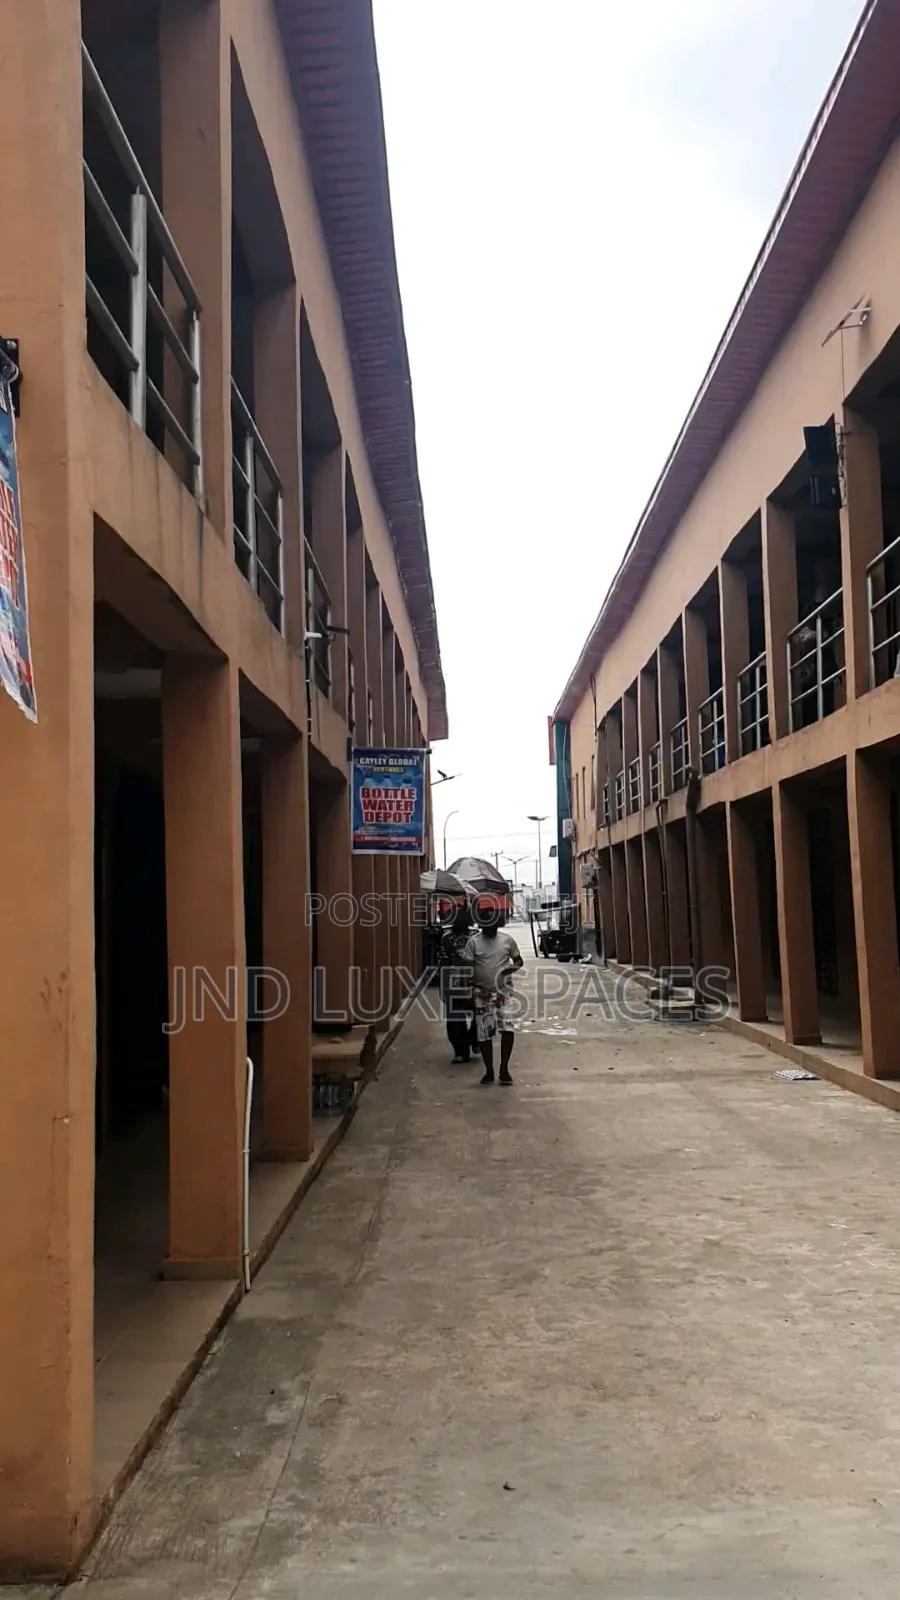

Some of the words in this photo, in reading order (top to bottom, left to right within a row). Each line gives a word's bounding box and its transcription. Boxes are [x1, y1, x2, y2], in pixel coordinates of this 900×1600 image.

[388, 758, 417, 766] GLOBAL
[361, 787, 416, 800] BOTTLE
[361, 799, 414, 811] WATER
[363, 811, 412, 823] DEPOT
